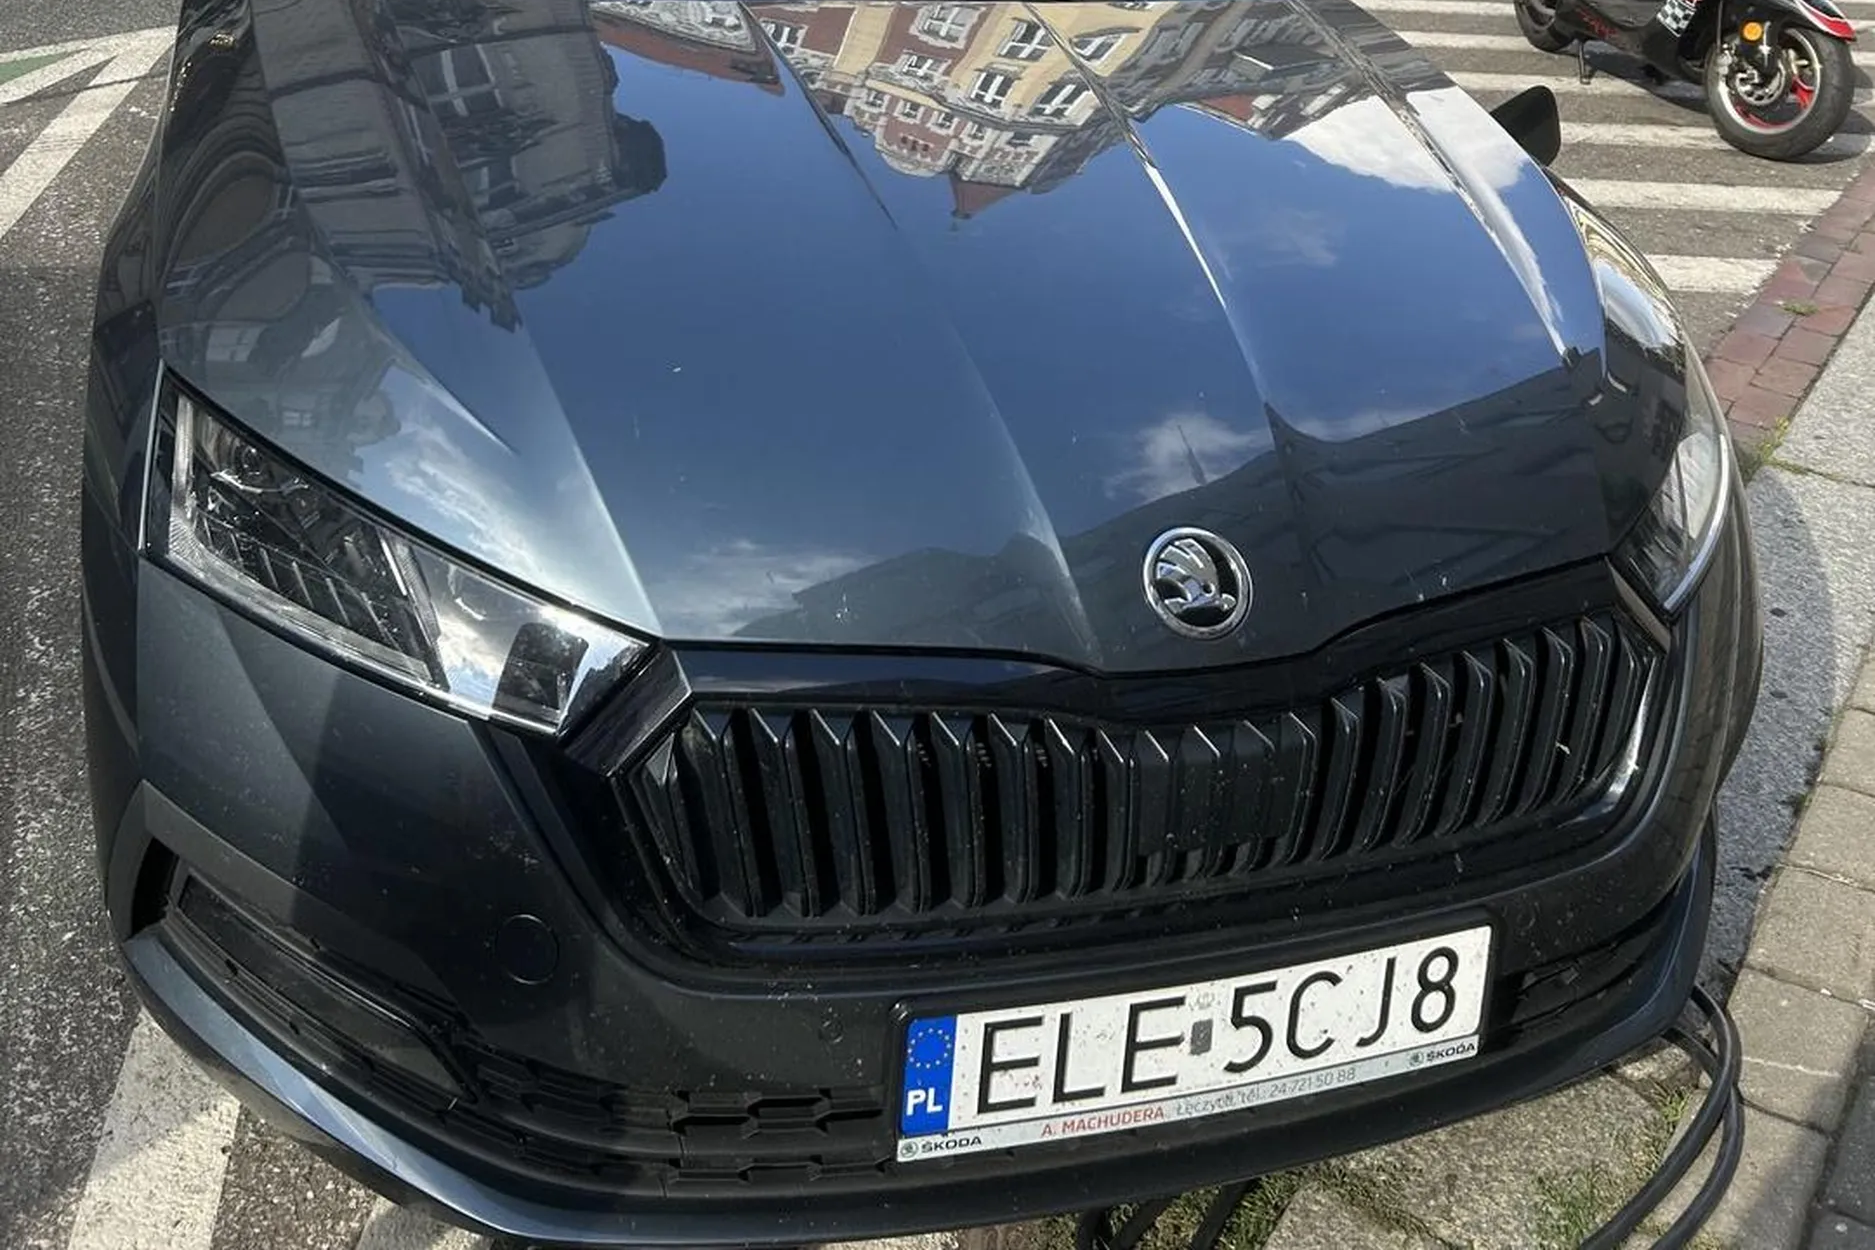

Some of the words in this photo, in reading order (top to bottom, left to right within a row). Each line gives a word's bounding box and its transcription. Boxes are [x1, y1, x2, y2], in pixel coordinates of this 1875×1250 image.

[976, 995, 1187, 1115] ELE
[1222, 945, 1461, 1075] 5CJ8
[906, 1086, 944, 1117] PL
[1040, 1123, 1057, 1139] A.
